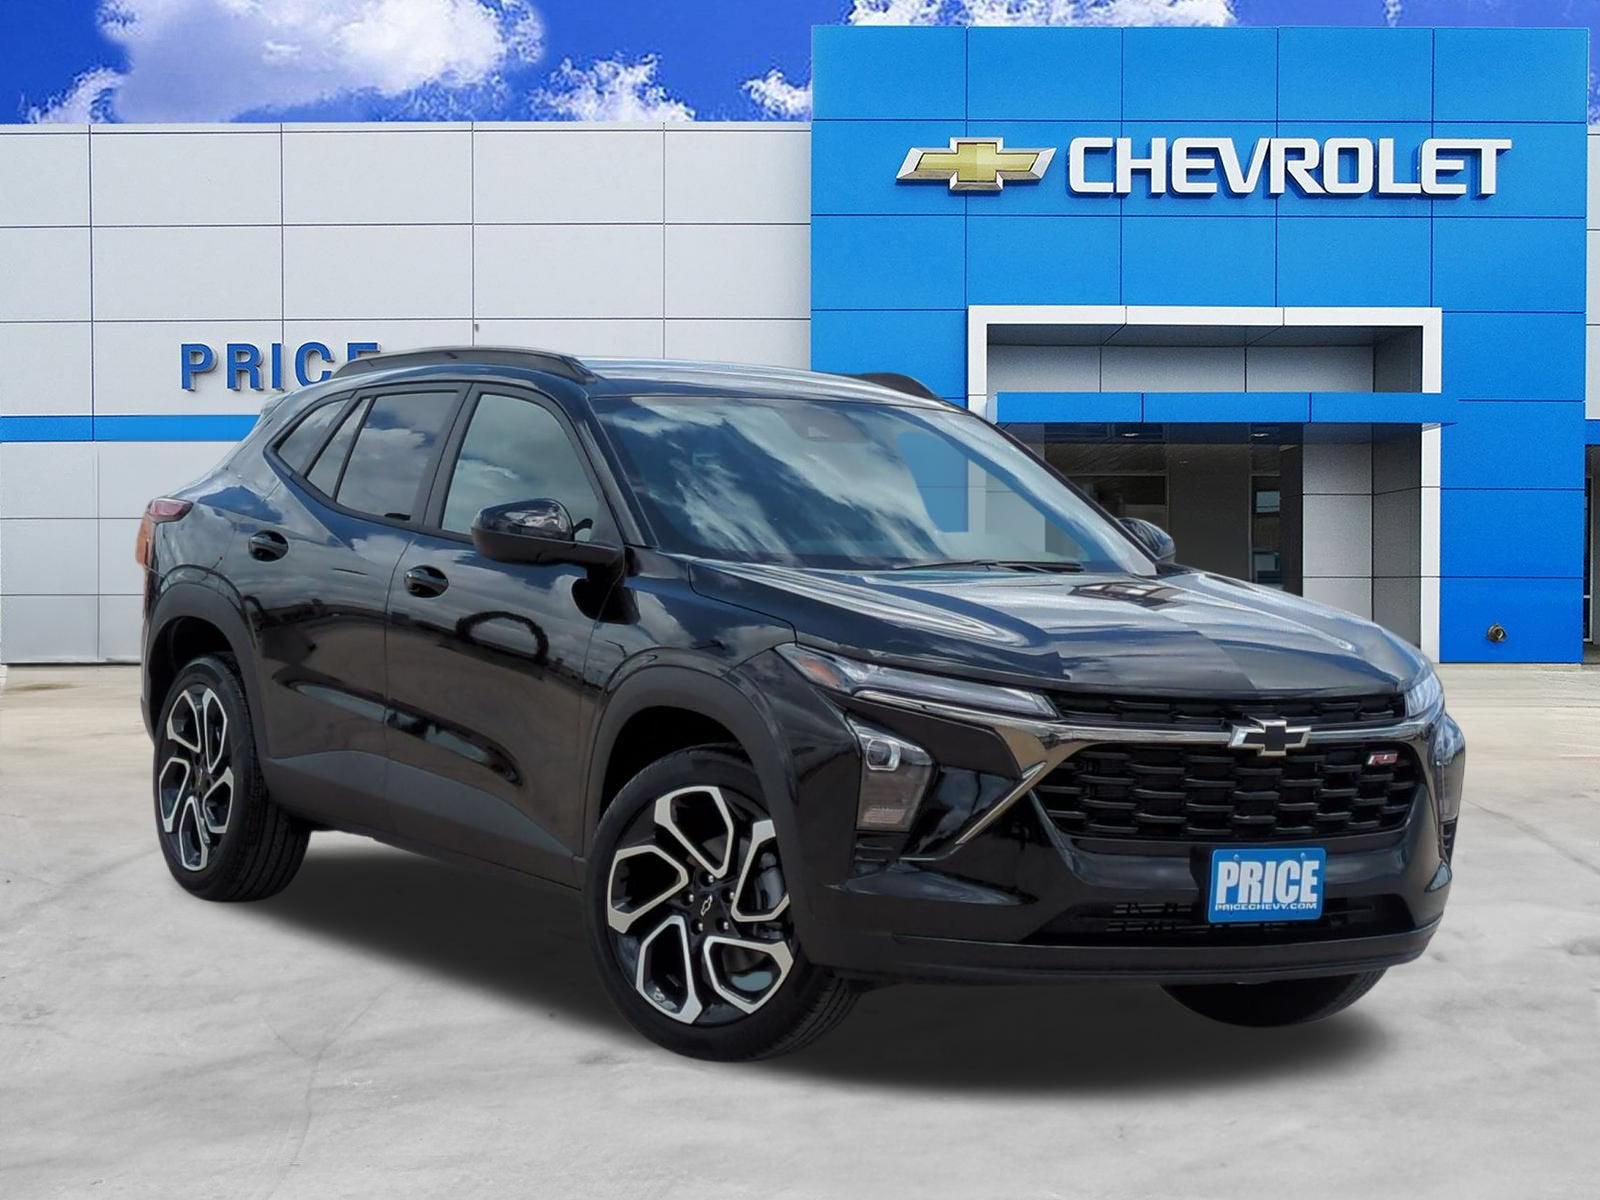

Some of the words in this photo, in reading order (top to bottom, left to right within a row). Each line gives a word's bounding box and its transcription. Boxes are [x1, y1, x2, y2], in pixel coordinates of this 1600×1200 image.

[1068, 137, 1512, 195] CHEVROLET
[1215, 860, 1320, 904] PRICE
[1214, 902, 1318, 911] PRICECHEVY.COM
